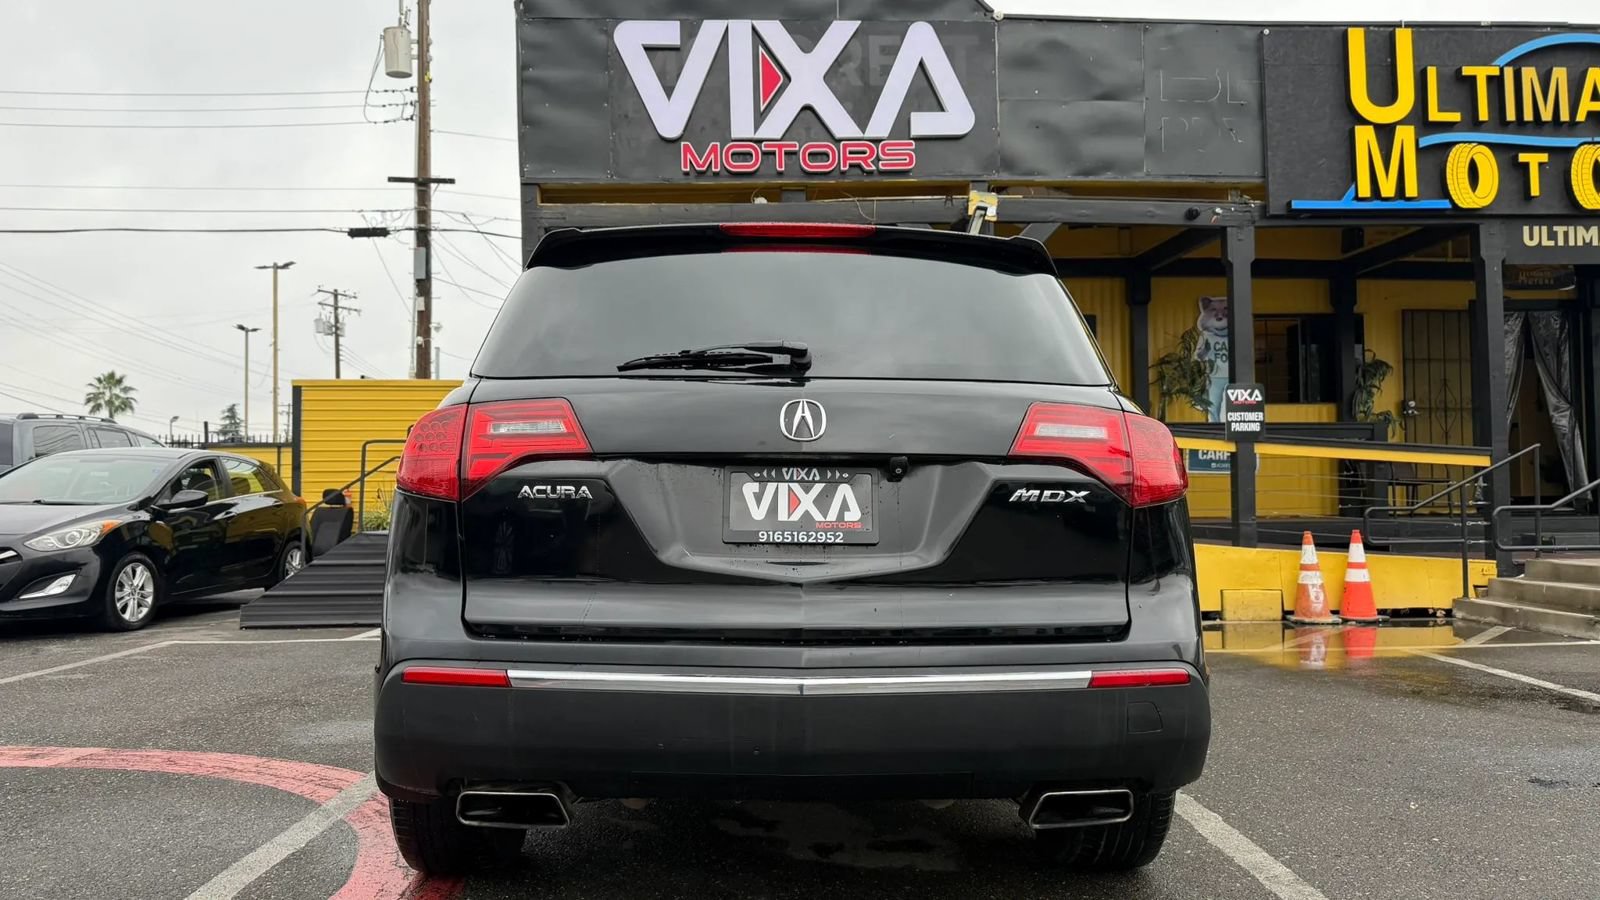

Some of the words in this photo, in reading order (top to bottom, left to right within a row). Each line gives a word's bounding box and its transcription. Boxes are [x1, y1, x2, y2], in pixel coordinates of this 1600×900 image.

[613, 20, 975, 140] VIXA
[680, 141, 916, 173] MOTORS
[1523, 225, 1600, 247] ULTIM
[1227, 389, 1263, 401] VIXA
[1227, 412, 1264, 422] CUSTOMER
[1231, 422, 1261, 432] PARKING
[782, 467, 820, 481] VIXA
[517, 485, 593, 499] ACURA
[1009, 488, 1091, 503] MDX
[742, 482, 862, 521] VIXA
[815, 521, 863, 529] MOTORS
[758, 531, 844, 543] 9165162952
